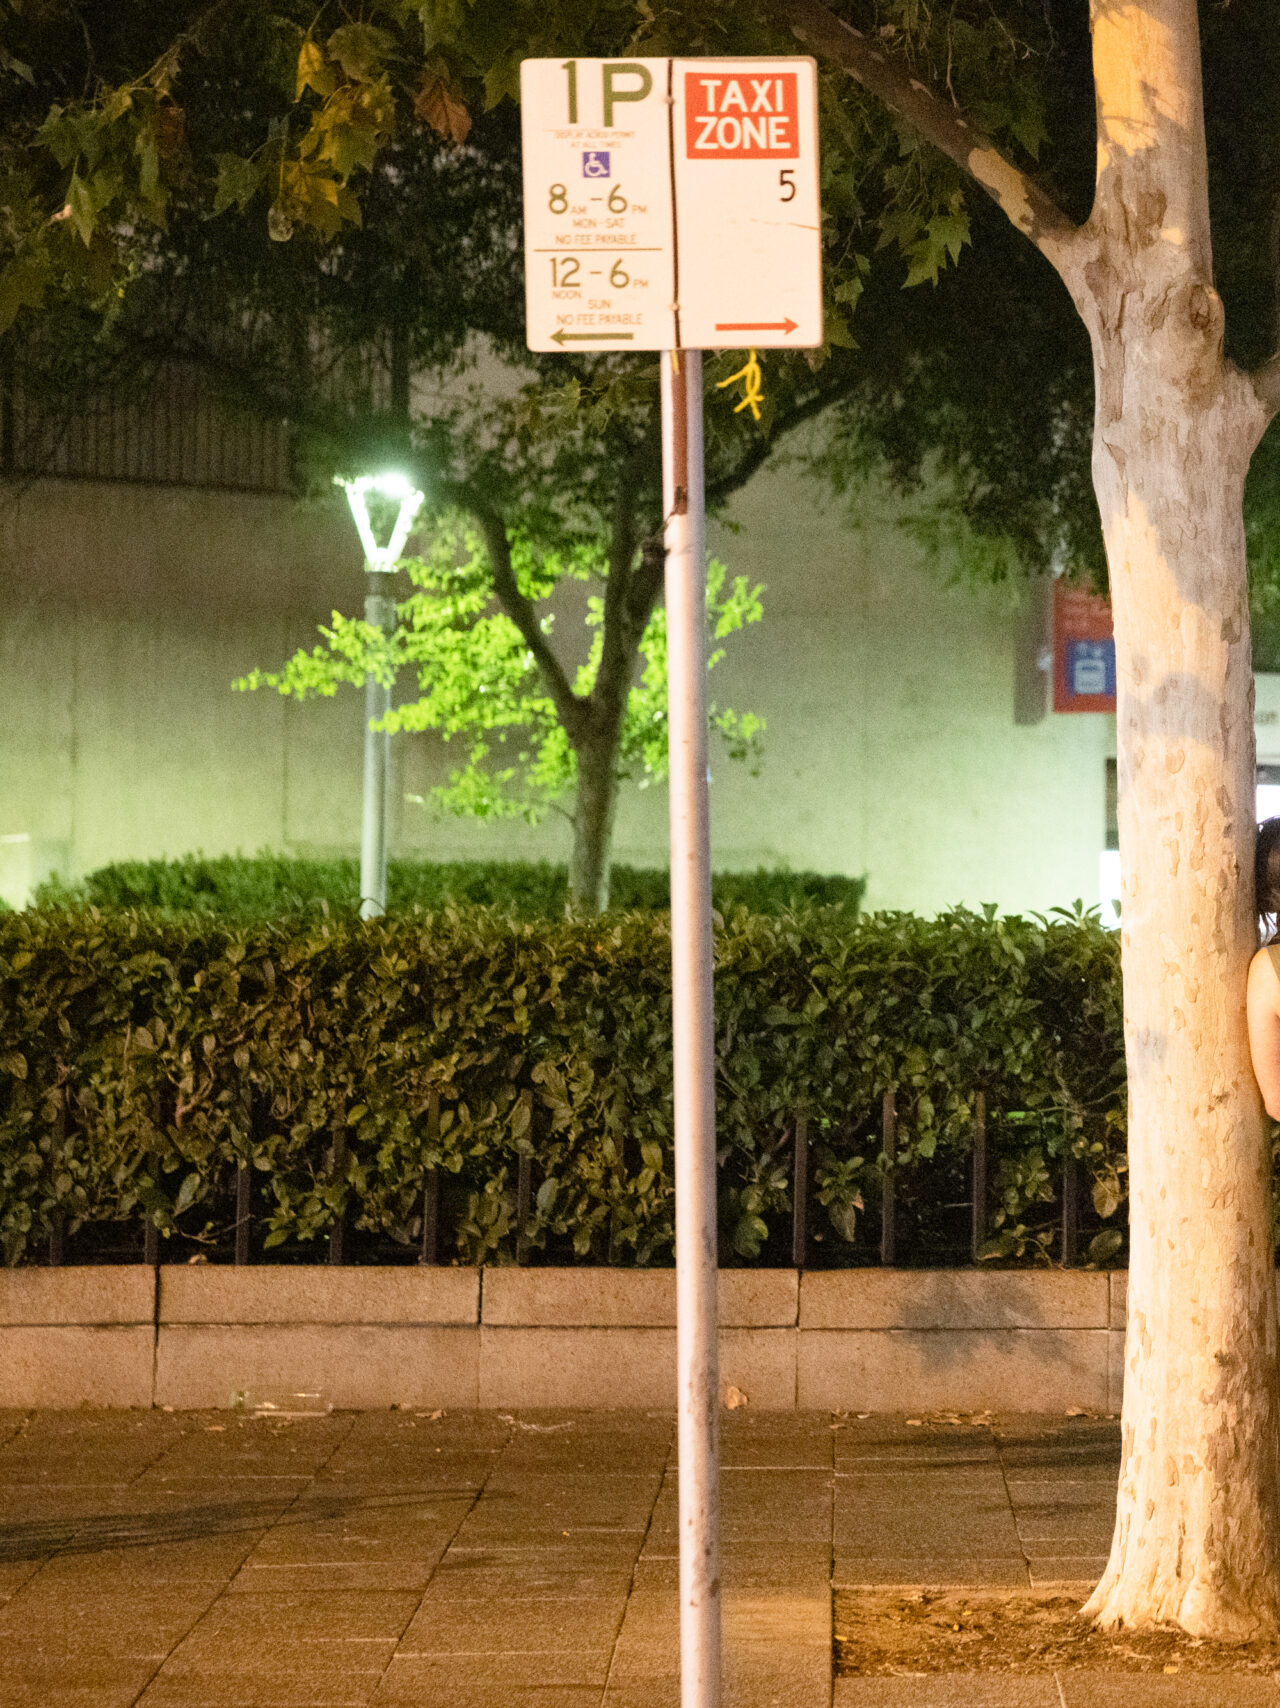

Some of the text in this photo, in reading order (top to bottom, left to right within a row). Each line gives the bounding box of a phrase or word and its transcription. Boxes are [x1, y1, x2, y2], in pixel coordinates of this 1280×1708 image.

[700, 79, 785, 113] TAXI
[694, 116, 791, 150] ZONE
[779, 169, 796, 203] 5
[555, 233, 637, 245] NO FEE PAYABLE
[550, 257, 581, 288] 12
[552, 289, 582, 300] NOON
[587, 299, 612, 310] SUN
[556, 312, 644, 325] NO FEE PAYABLE
